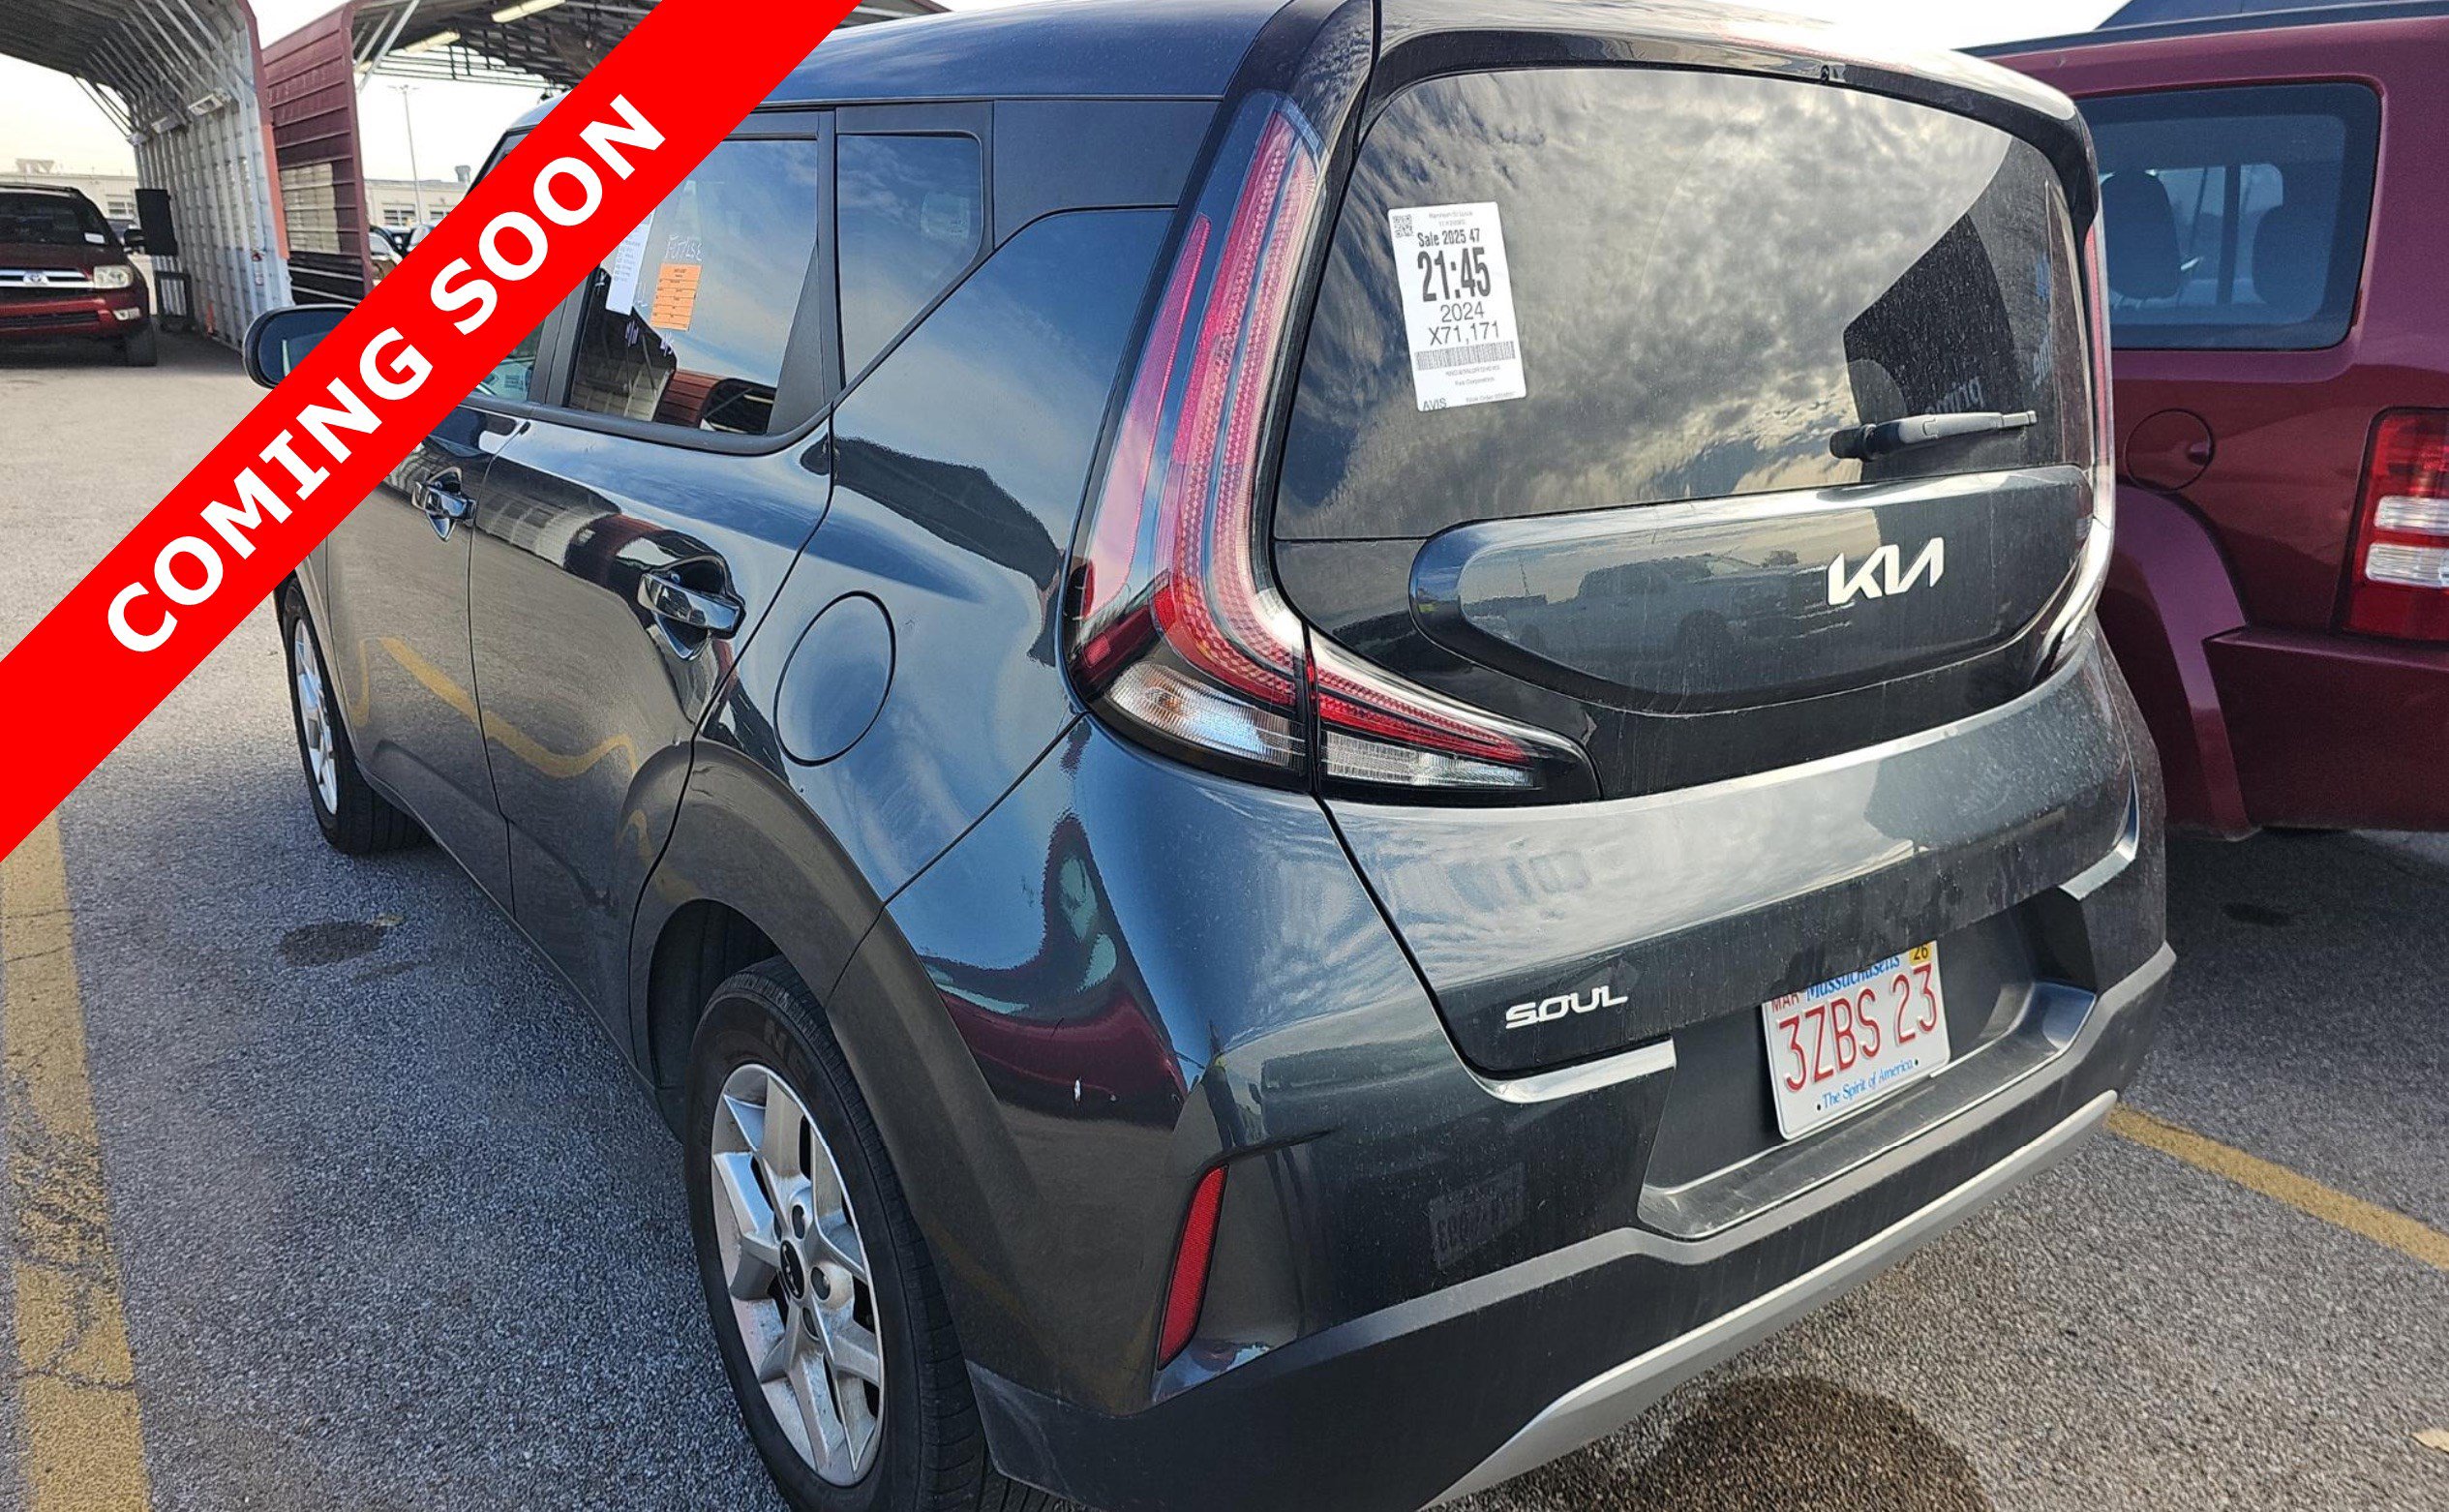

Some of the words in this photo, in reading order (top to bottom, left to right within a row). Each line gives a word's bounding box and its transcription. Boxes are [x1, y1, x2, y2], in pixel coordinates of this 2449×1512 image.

[1417, 231, 1439, 248] Sale
[1442, 228, 1466, 245] 2025
[1468, 227, 1480, 243] 47
[1417, 247, 1492, 302] 21:45
[1429, 321, 1500, 346] X71,171
[1439, 303, 1485, 323] 2024
[1422, 397, 1447, 410] AVIS
[1828, 536, 1945, 606] KIA
[1771, 992, 1799, 1013] MAR
[1913, 944, 1929, 961] 26
[1505, 984, 1629, 1030] SOUL
[1778, 987, 1882, 1092] 3ZBS
[1891, 963, 1937, 1046] 23
[1822, 1092, 1840, 1108] The
[1842, 1078, 1866, 1101] Spirit
[1868, 1071, 1877, 1089] of
[1879, 1059, 1914, 1083] America
